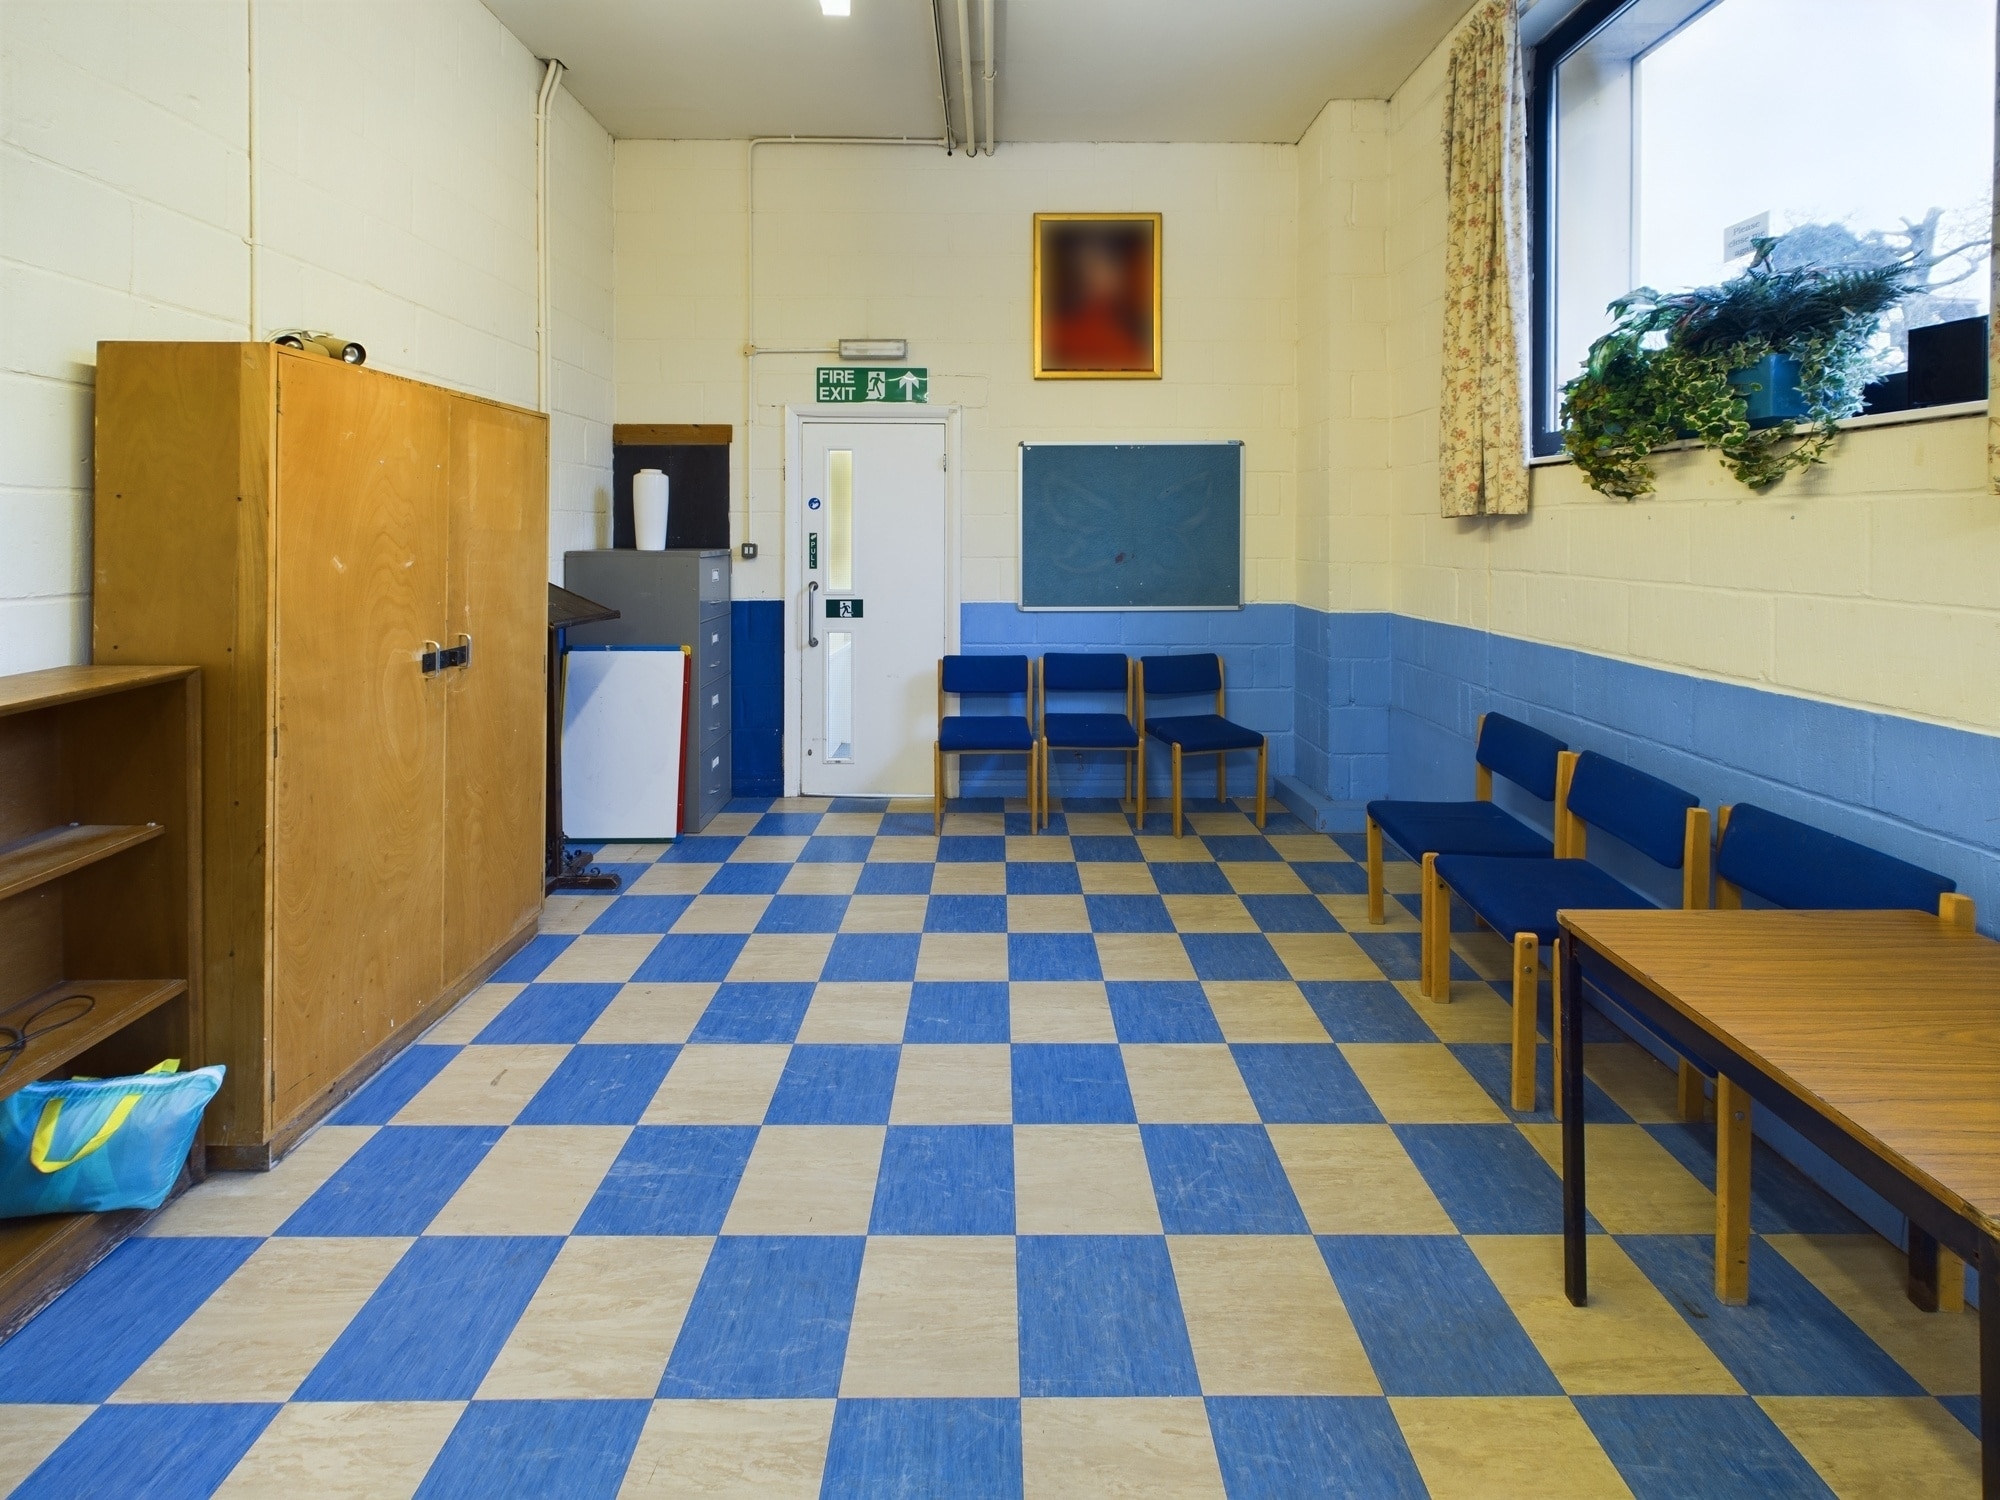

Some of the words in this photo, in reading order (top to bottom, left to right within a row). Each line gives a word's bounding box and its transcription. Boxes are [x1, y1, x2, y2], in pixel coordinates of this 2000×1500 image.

[1733, 221, 1760, 236] Please
[1728, 237, 1749, 248] close
[819, 370, 855, 384] FIRE
[819, 387, 856, 401] EXIT
